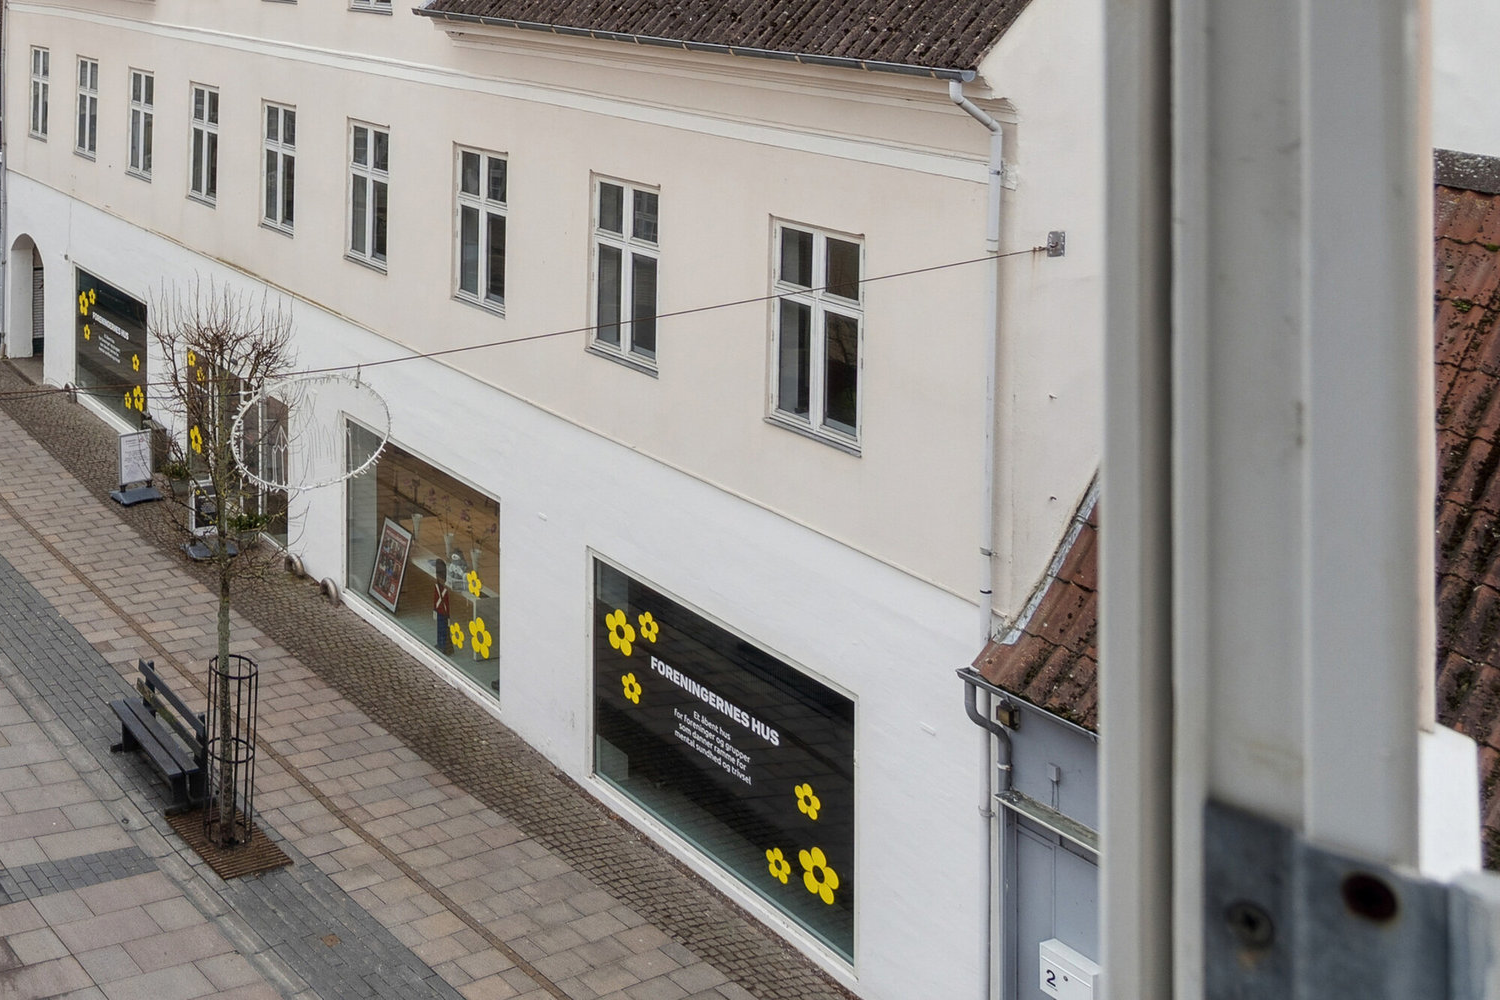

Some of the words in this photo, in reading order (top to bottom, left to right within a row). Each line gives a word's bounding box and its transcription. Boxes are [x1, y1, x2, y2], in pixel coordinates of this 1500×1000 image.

[651, 656, 750, 728] FORENINGERNES
[751, 717, 780, 746] HUS
[674, 708, 683, 720] for
[684, 714, 715, 740] foreninger
[716, 737, 724, 748] og
[725, 743, 751, 763] grupper
[679, 723, 691, 735] som
[692, 731, 713, 749] danner
[714, 745, 736, 764] ramme
[736, 758, 747, 770] for
[701, 715, 719, 733] åbent
[720, 727, 731, 740] hus
[674, 730, 695, 748] mental
[696, 744, 721, 765] sundhed
[722, 761, 730, 773] og
[731, 766, 751, 785] trivsel
[1046, 969, 1056, 987] 2
